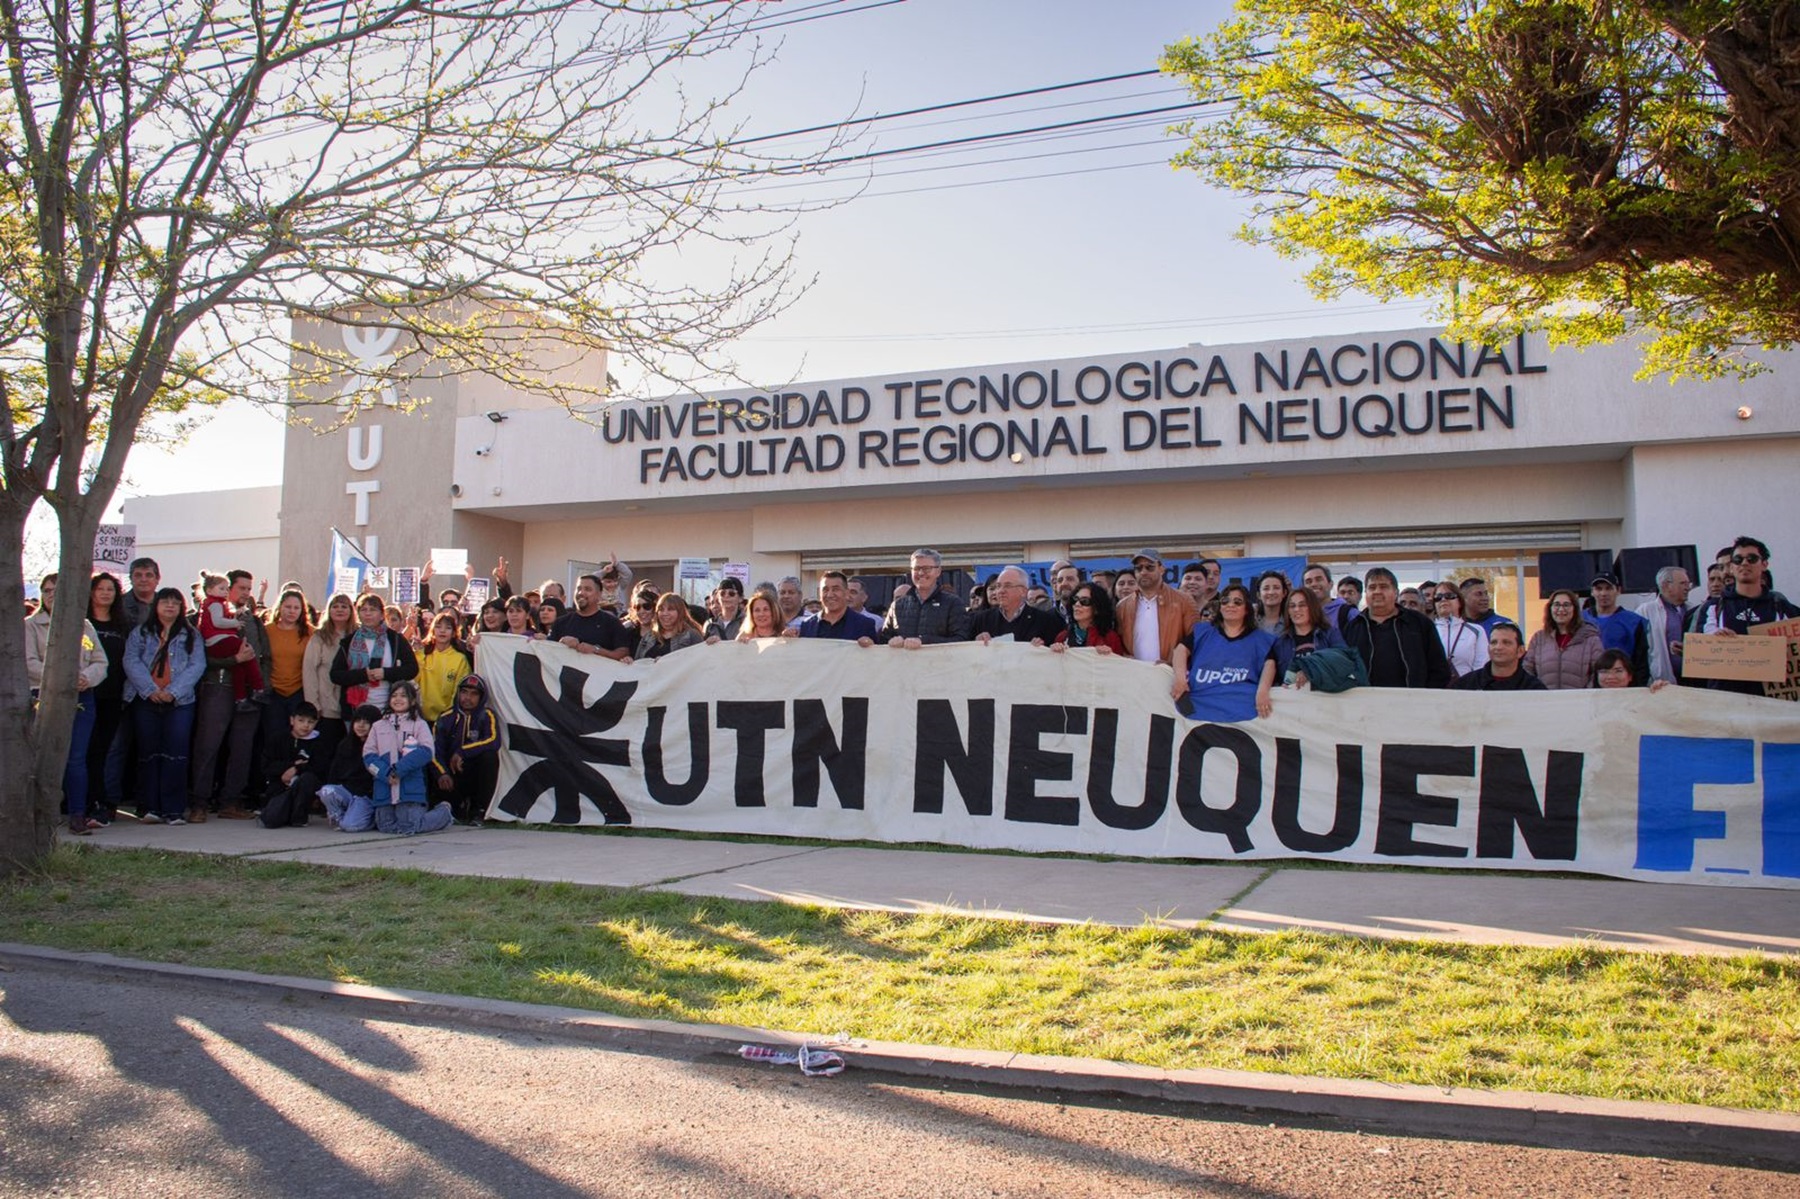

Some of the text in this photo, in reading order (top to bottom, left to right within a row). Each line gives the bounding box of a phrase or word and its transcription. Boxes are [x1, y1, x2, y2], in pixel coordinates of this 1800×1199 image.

[603, 328, 1548, 444] UNIVERSIDAD TECNOLOGICA NACIONAL
[640, 384, 1515, 484] FACULTAD REGIONAL DEL NEUQUEN
[99, 536, 109, 546] SE
[102, 548, 128, 561] CALLES
[1195, 669, 1248, 684] UPCN
[642, 697, 869, 810] UTN
[914, 699, 1584, 861] NEUQUEN
